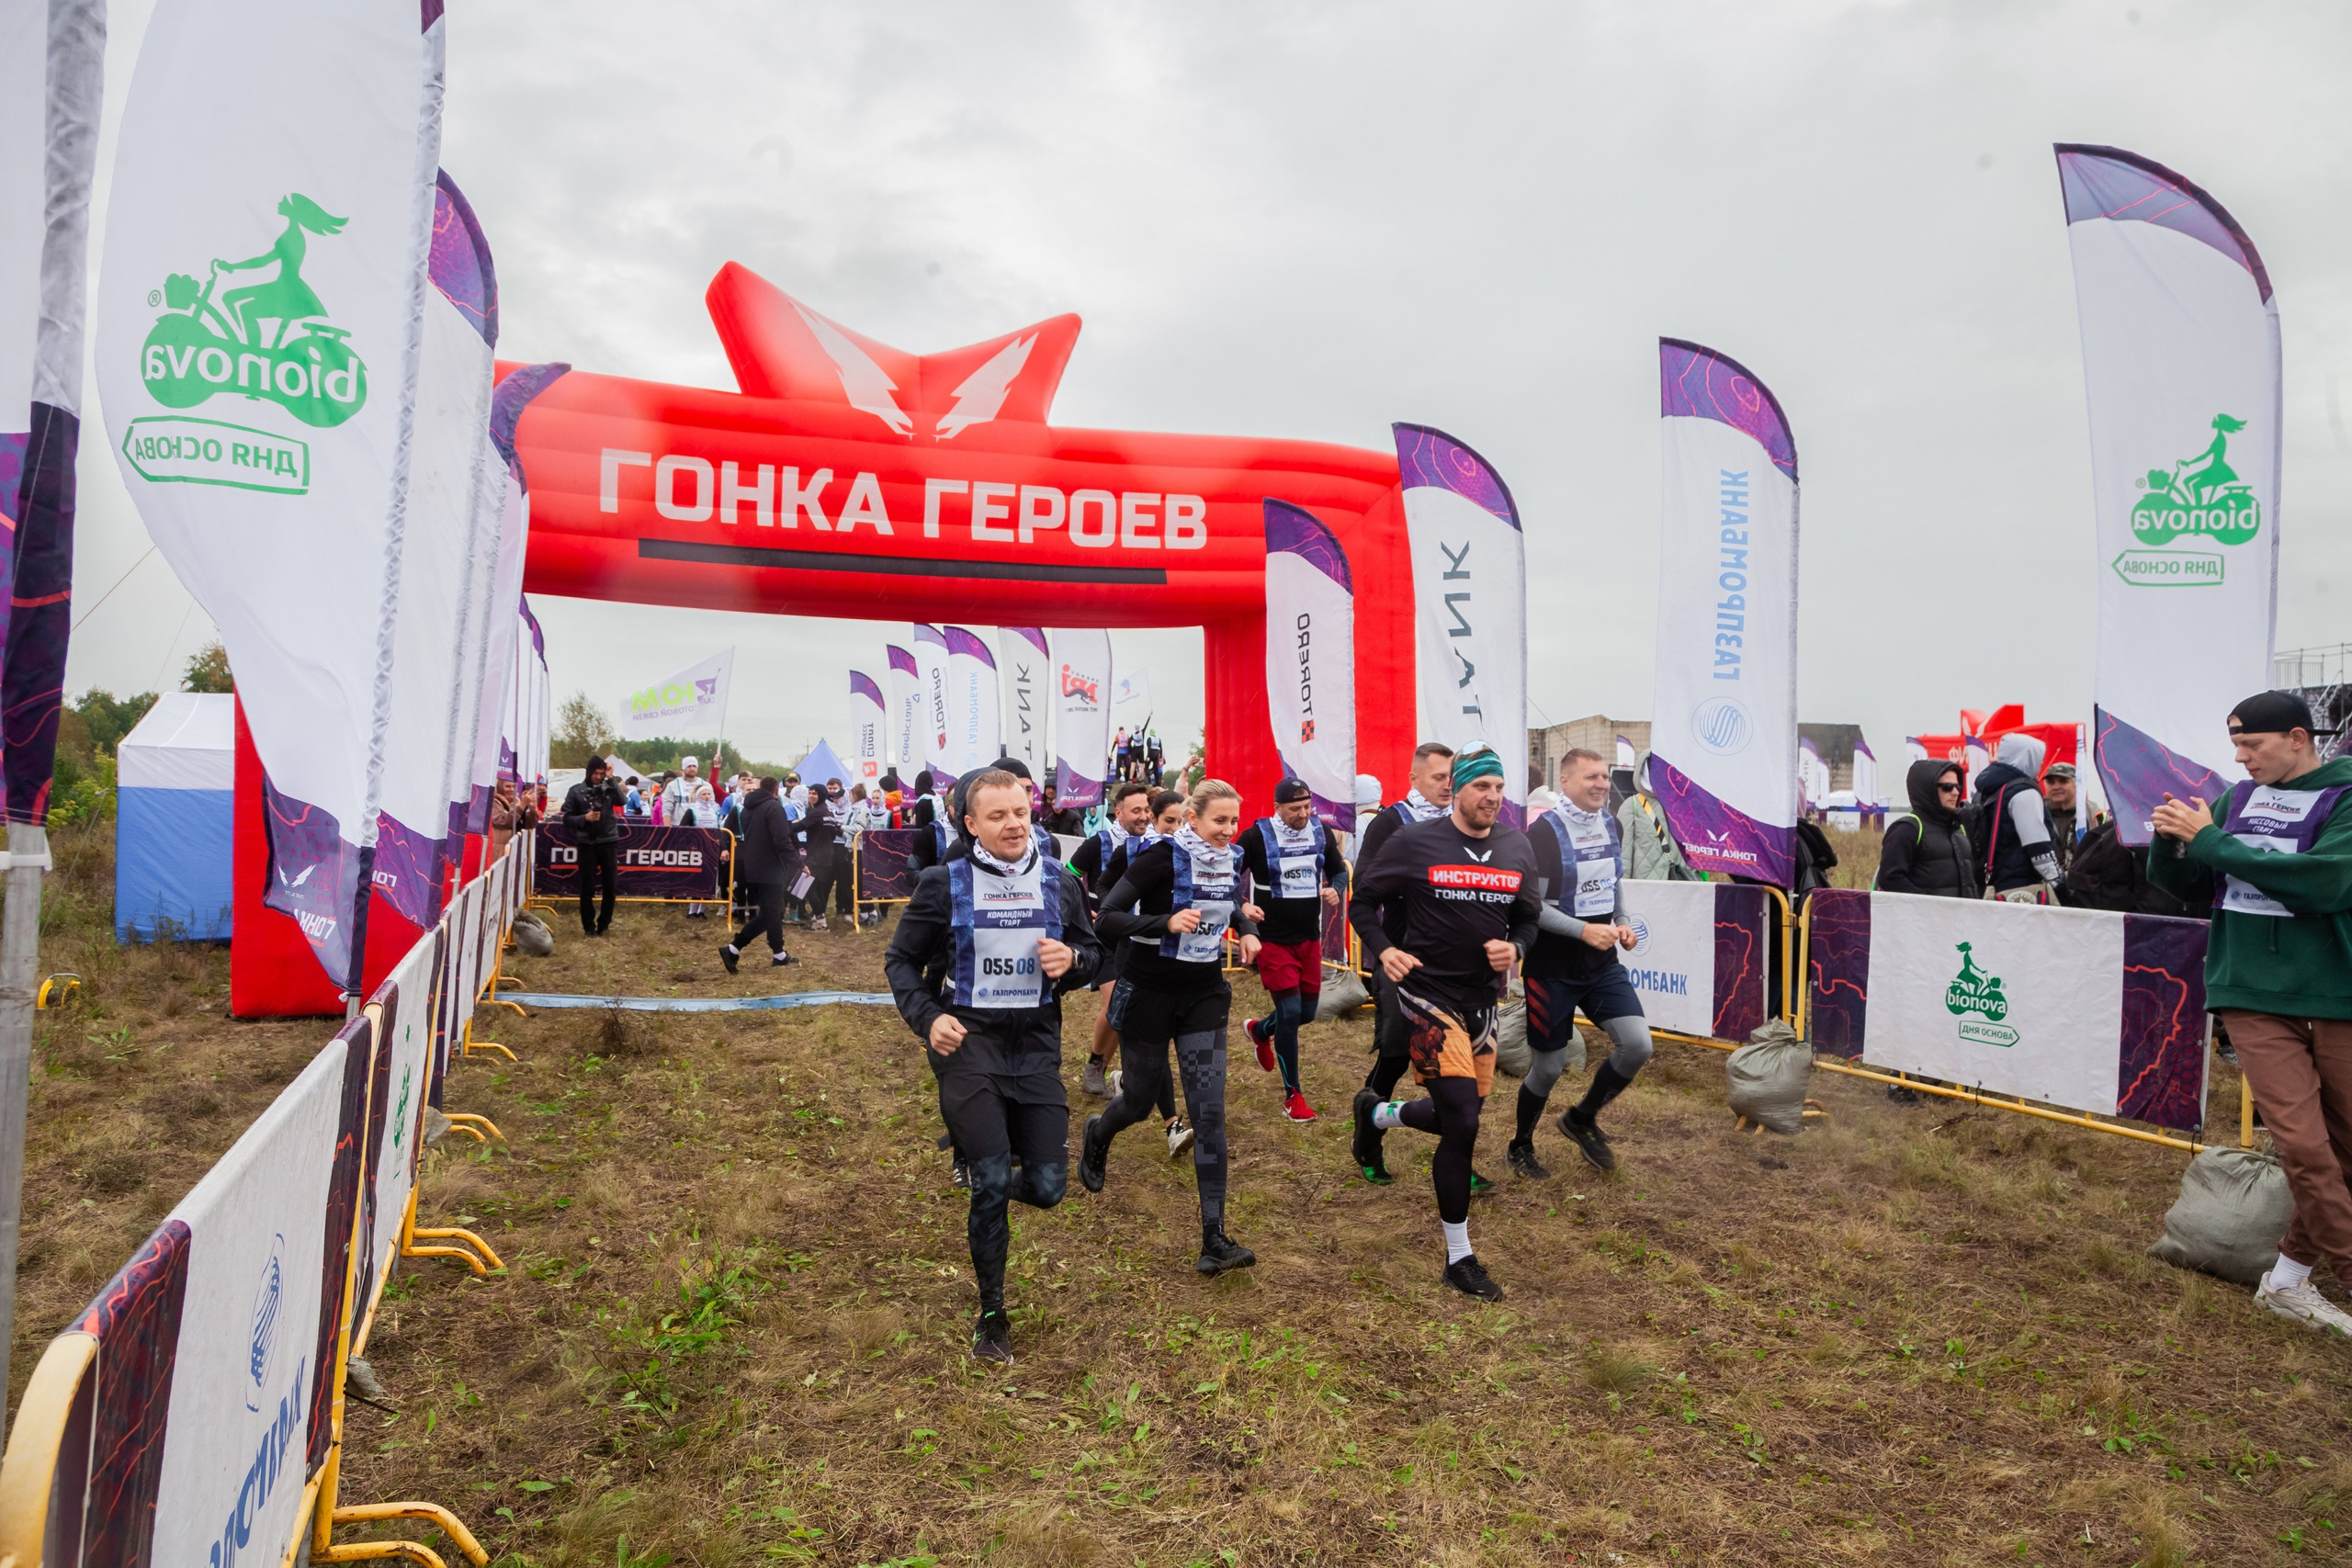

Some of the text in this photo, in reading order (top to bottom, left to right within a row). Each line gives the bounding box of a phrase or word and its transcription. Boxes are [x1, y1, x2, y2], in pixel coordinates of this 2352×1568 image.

[598, 446, 1208, 551] ГОНКА ГЕРОЕВ
[2247, 817, 2289, 830] МАССОВЫЙ
[2252, 826, 2275, 835] СТАРТ
[626, 849, 703, 866] ГЕРОЕВ
[1432, 870, 1521, 888] ИНСТРУКТОР
[1434, 888, 1476, 901] ГОНКА
[986, 908, 1034, 919] КОМАНДНЫЙ
[999, 919, 1022, 928] СТАРТ
[992, 988, 1038, 997] ГАЗПРОМБАНК
[1947, 987, 2007, 1014] bionova
[1962, 1024, 2014, 1041] ДНЯ ОСНОВА
